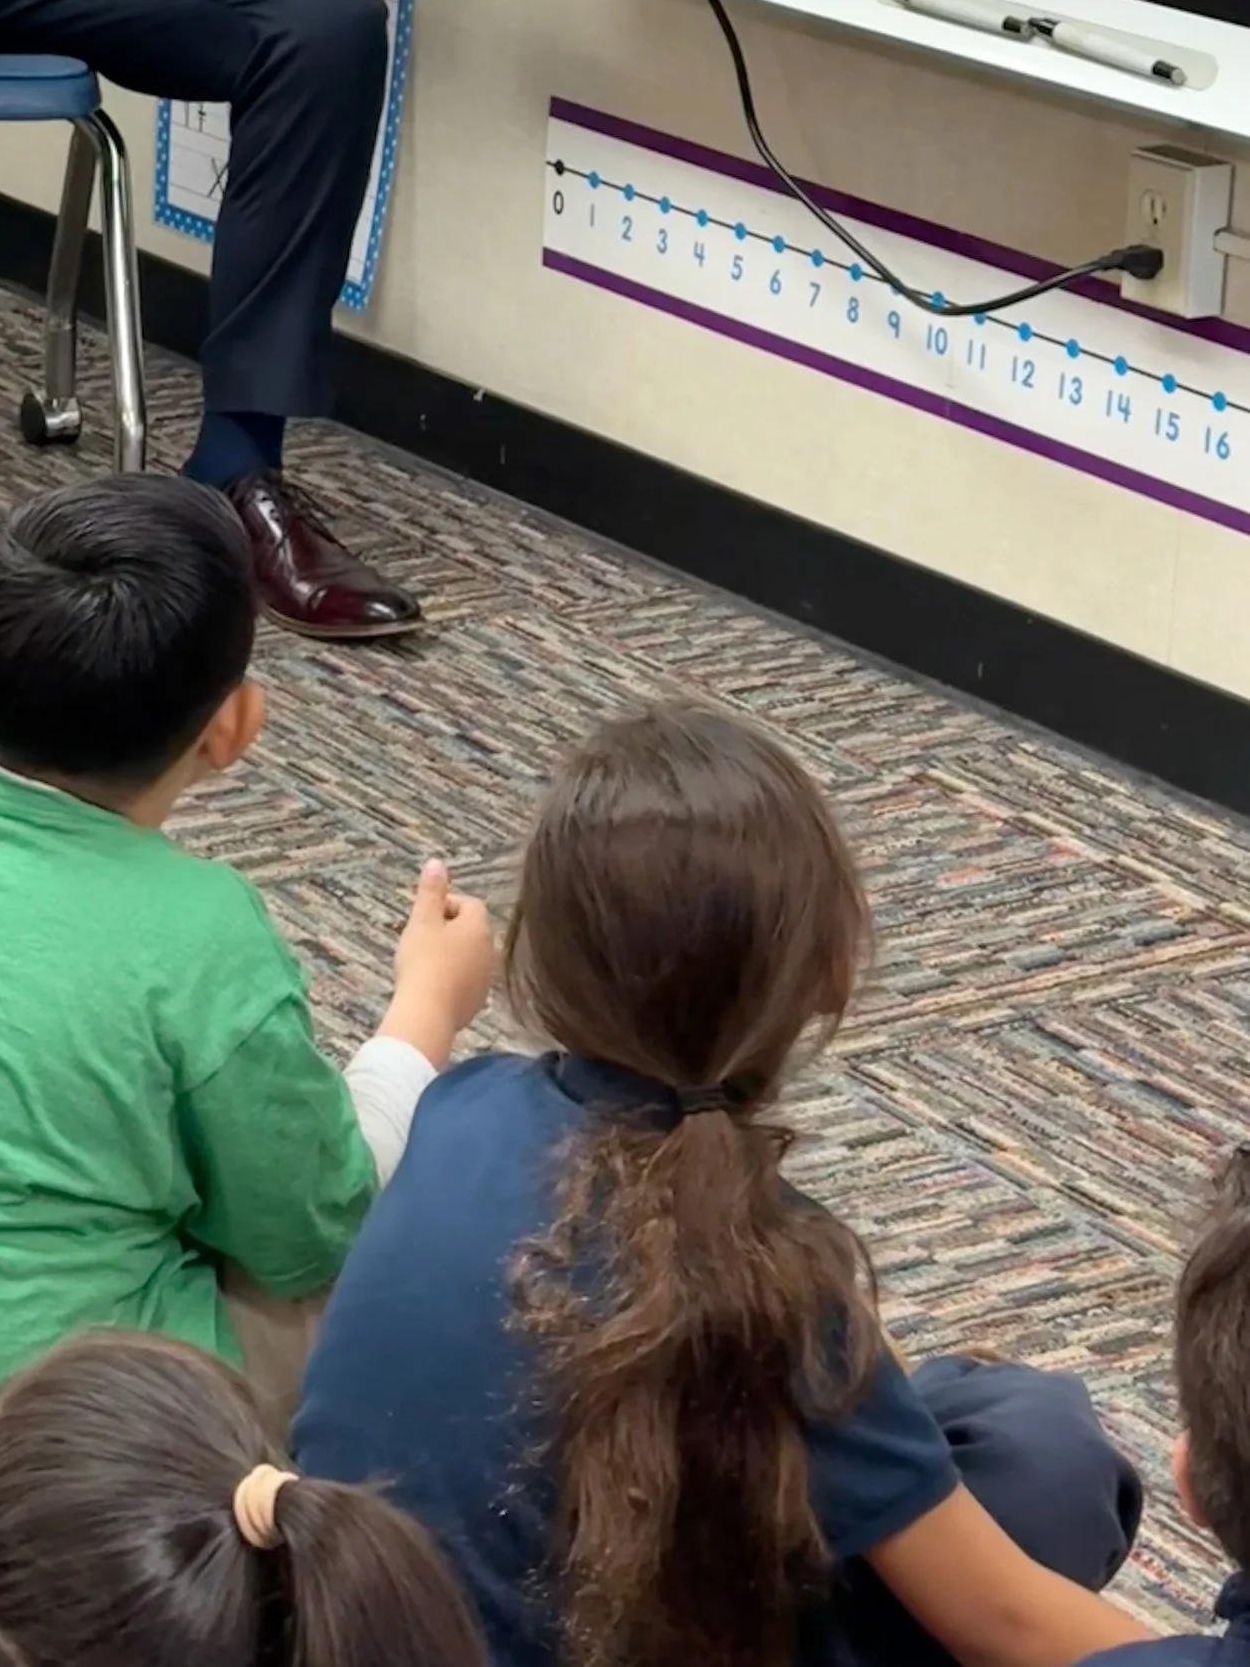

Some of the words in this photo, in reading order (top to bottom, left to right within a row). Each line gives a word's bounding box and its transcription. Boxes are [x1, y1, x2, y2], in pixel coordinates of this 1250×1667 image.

[553, 190, 565, 215] 0
[589, 202, 595, 228] 1
[621, 215, 633, 242] 2
[656, 228, 668, 255] 3
[693, 241, 705, 268] 4
[731, 255, 744, 281] 5
[770, 269, 782, 296] 6
[809, 281, 821, 308] 7
[846, 296, 860, 323] 8
[887, 309, 901, 339] 9
[926, 323, 948, 356] 10
[967, 338, 986, 371] 11
[1011, 355, 1036, 389] 12
[1058, 372, 1083, 406] 13
[1105, 389, 1132, 424] 14
[1154, 407, 1181, 442] 15
[1204, 425, 1231, 460] 16
